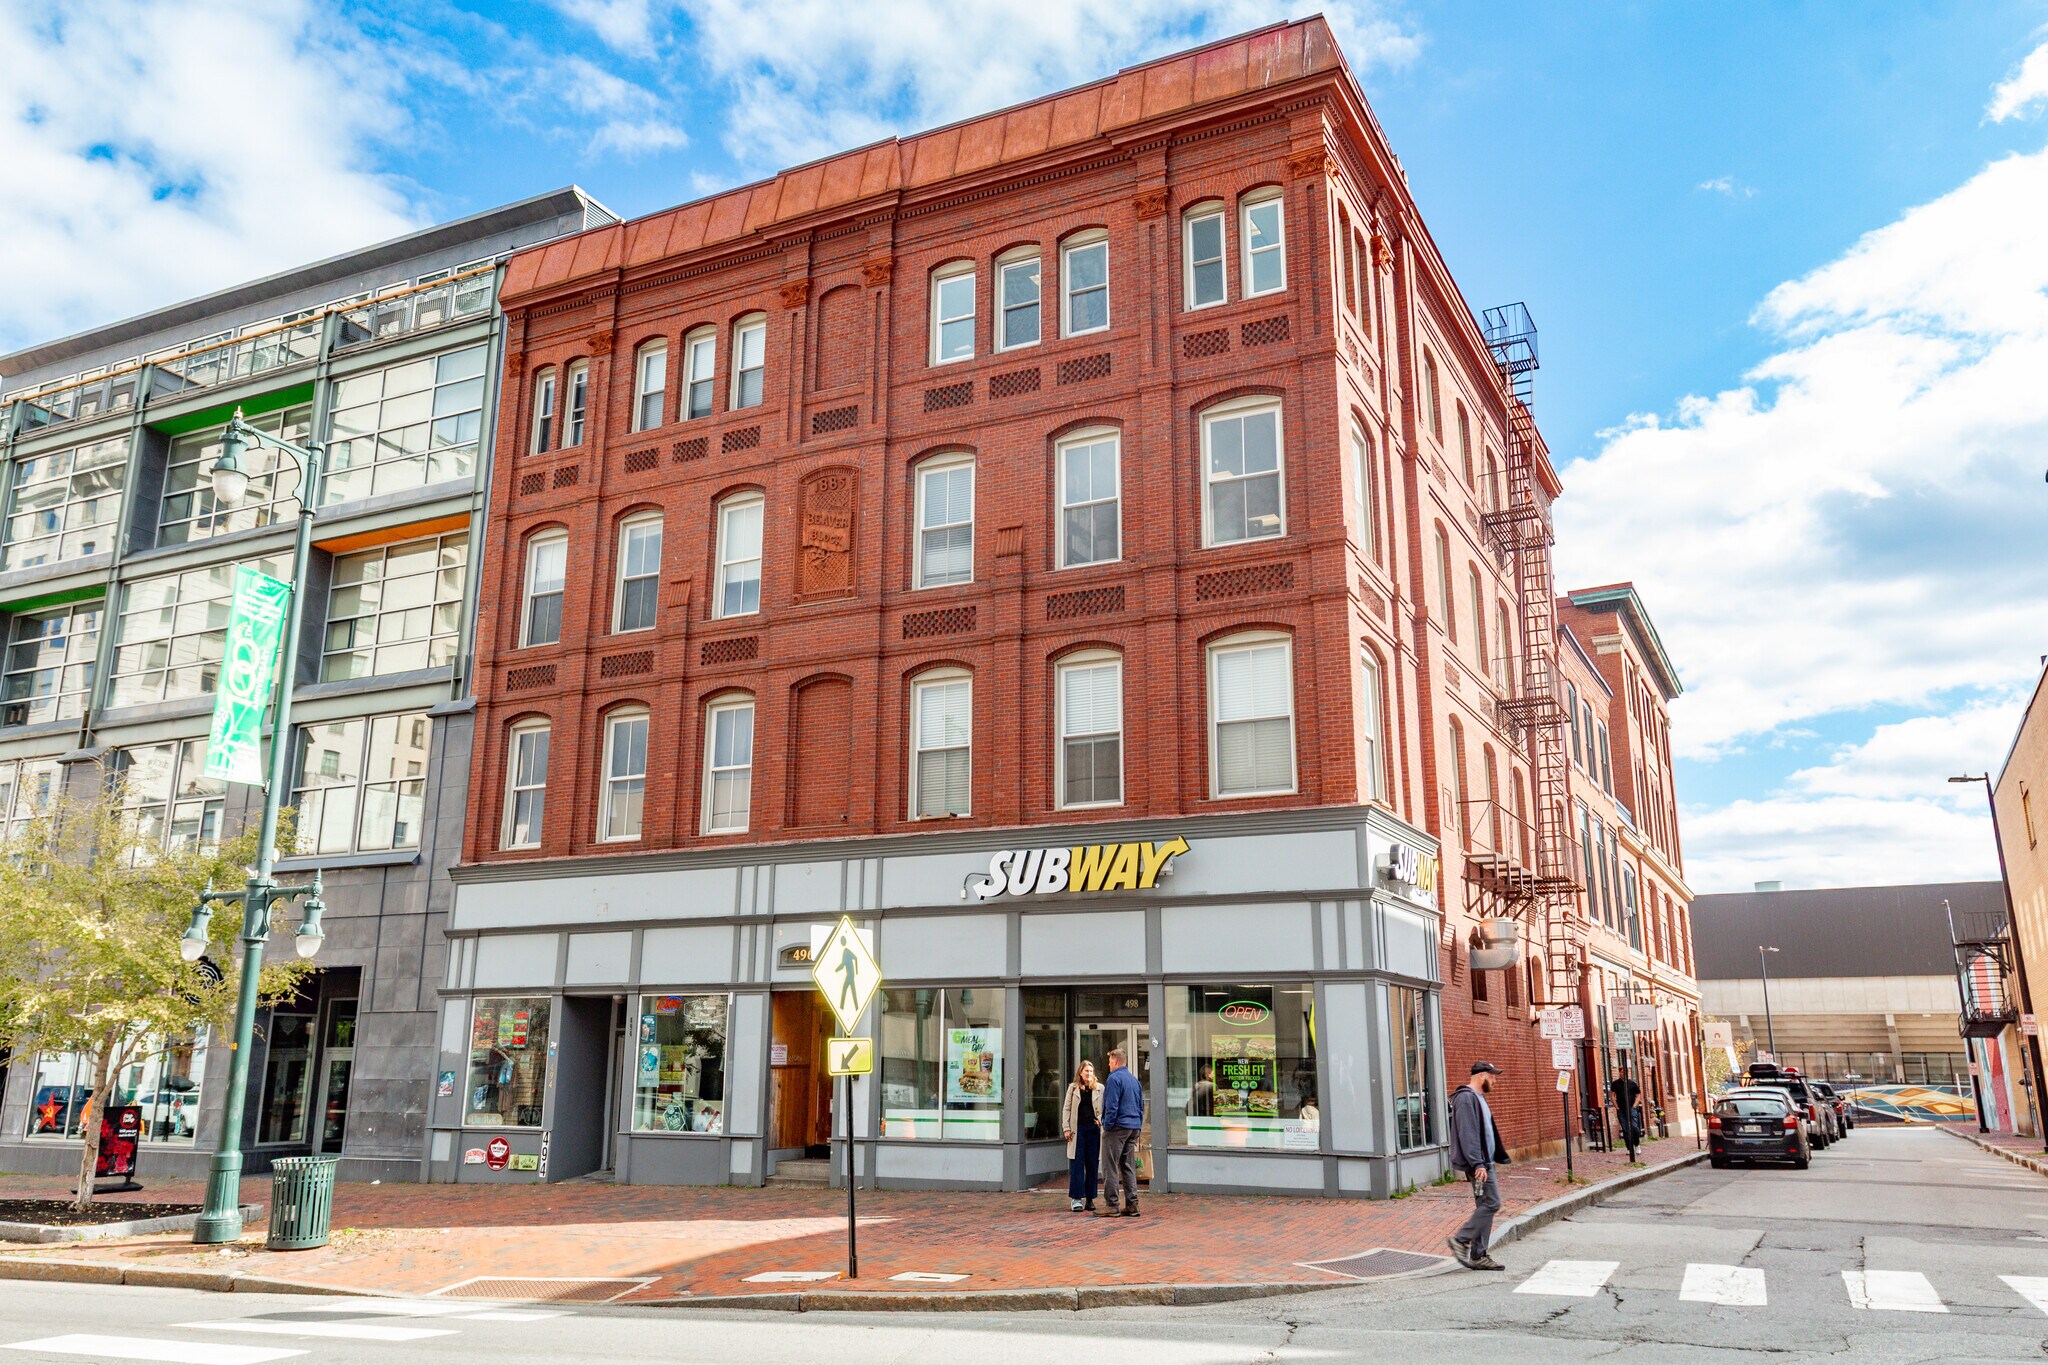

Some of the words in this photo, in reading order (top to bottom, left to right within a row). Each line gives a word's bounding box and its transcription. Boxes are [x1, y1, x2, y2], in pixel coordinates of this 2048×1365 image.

[815, 476, 846, 493] 1885
[807, 513, 848, 528] BEAVER
[811, 530, 844, 545] BLOCK
[228, 637, 260, 706] 100
[251, 646, 271, 711] ANNIVERSARY
[973, 835, 1190, 900] SUBWAY
[1391, 844, 1440, 891] SUBWAY
[1125, 999, 1139, 1008] 498
[1225, 1005, 1262, 1021] OPEN
[960, 1035, 979, 1044] MEAL
[971, 1043, 985, 1053] DAY
[1222, 1064, 1250, 1076] FRESH
[1252, 1064, 1266, 1076] FIT
[1285, 1126, 1293, 1134] NO
[539, 1131, 550, 1177] 494
